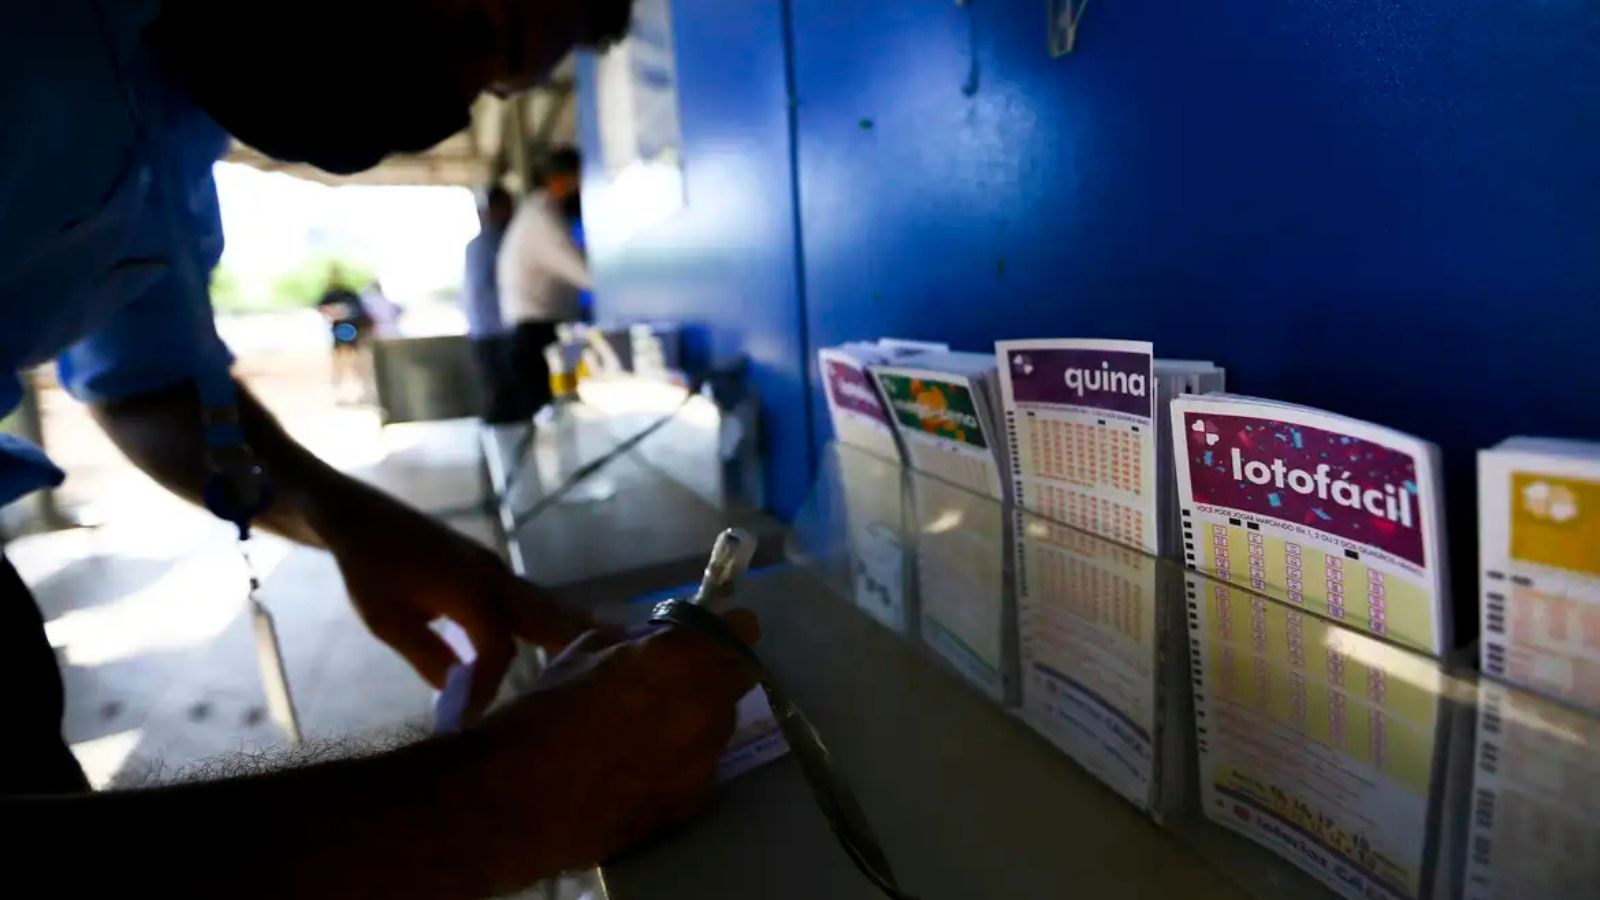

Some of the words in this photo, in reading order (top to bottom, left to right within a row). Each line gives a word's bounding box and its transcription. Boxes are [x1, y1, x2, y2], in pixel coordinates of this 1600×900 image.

[1064, 361, 1146, 397] quina
[1230, 447, 1412, 528] lotofácil
[1214, 508, 1231, 516] PODE
[1233, 512, 1254, 520] JOGAR
[1256, 517, 1294, 531] MARCANDO
